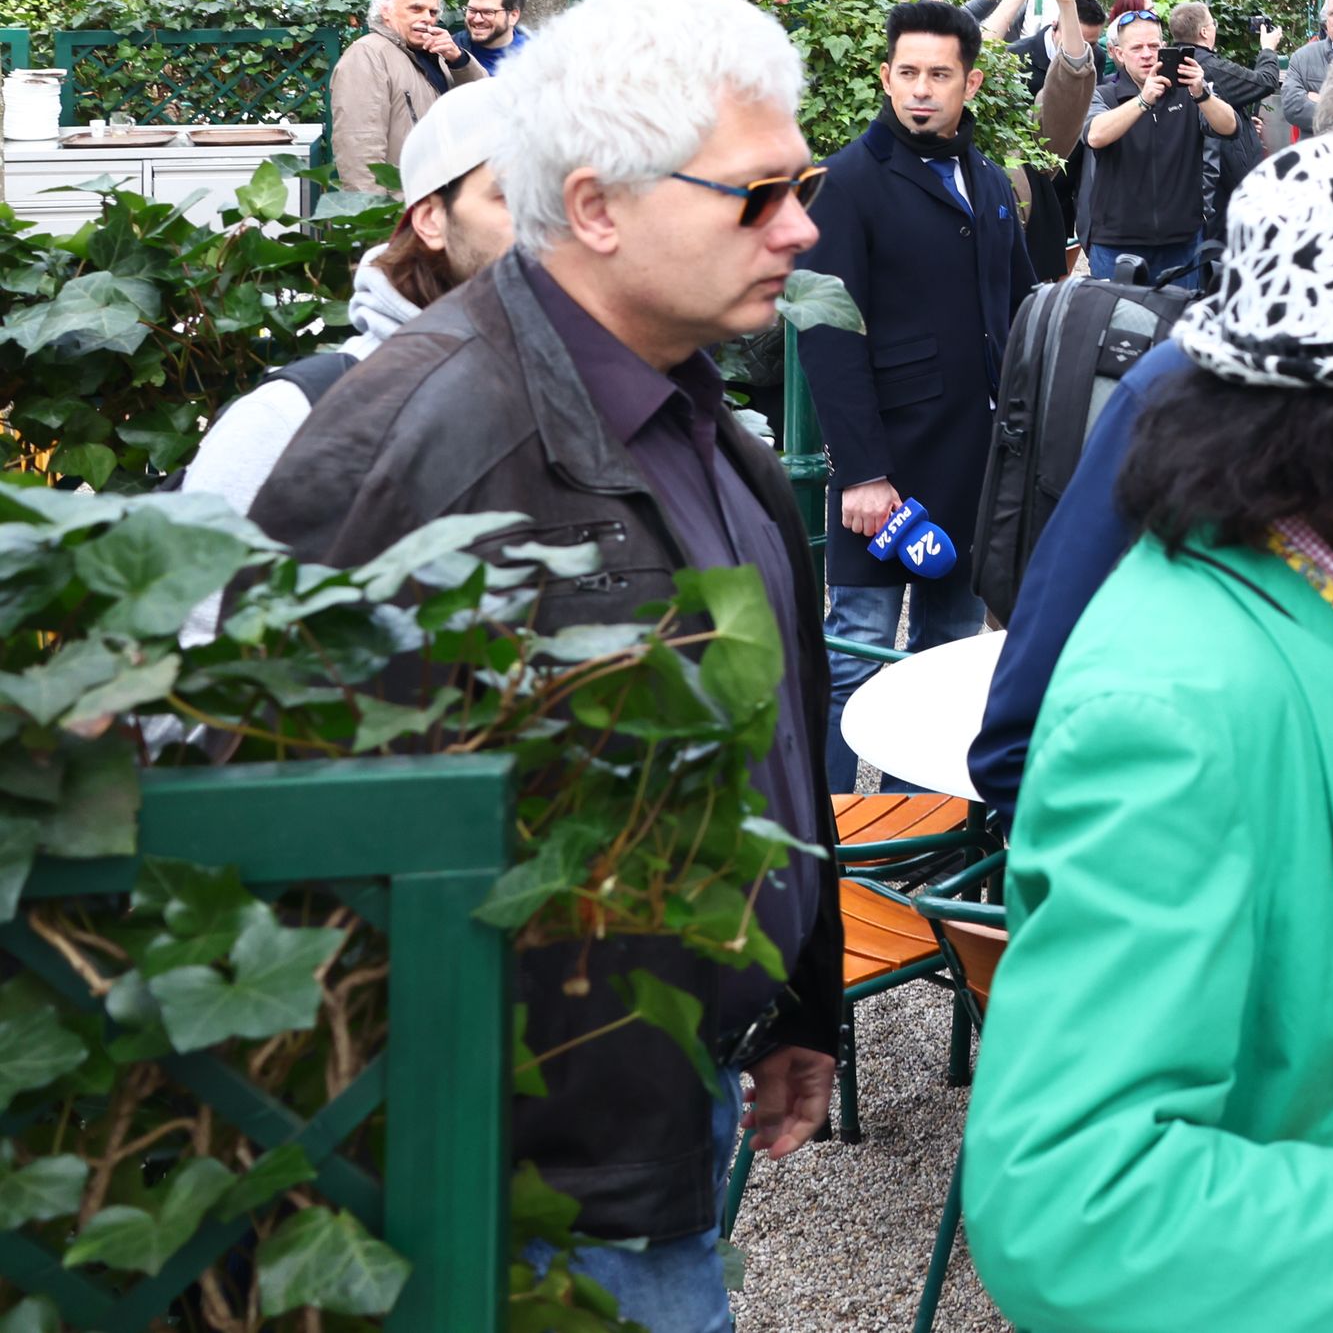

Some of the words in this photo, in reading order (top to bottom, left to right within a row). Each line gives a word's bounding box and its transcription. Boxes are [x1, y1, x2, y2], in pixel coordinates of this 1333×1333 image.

[887, 505, 912, 534] PULS
[875, 530, 892, 549] 24
[906, 530, 941, 566] 24
